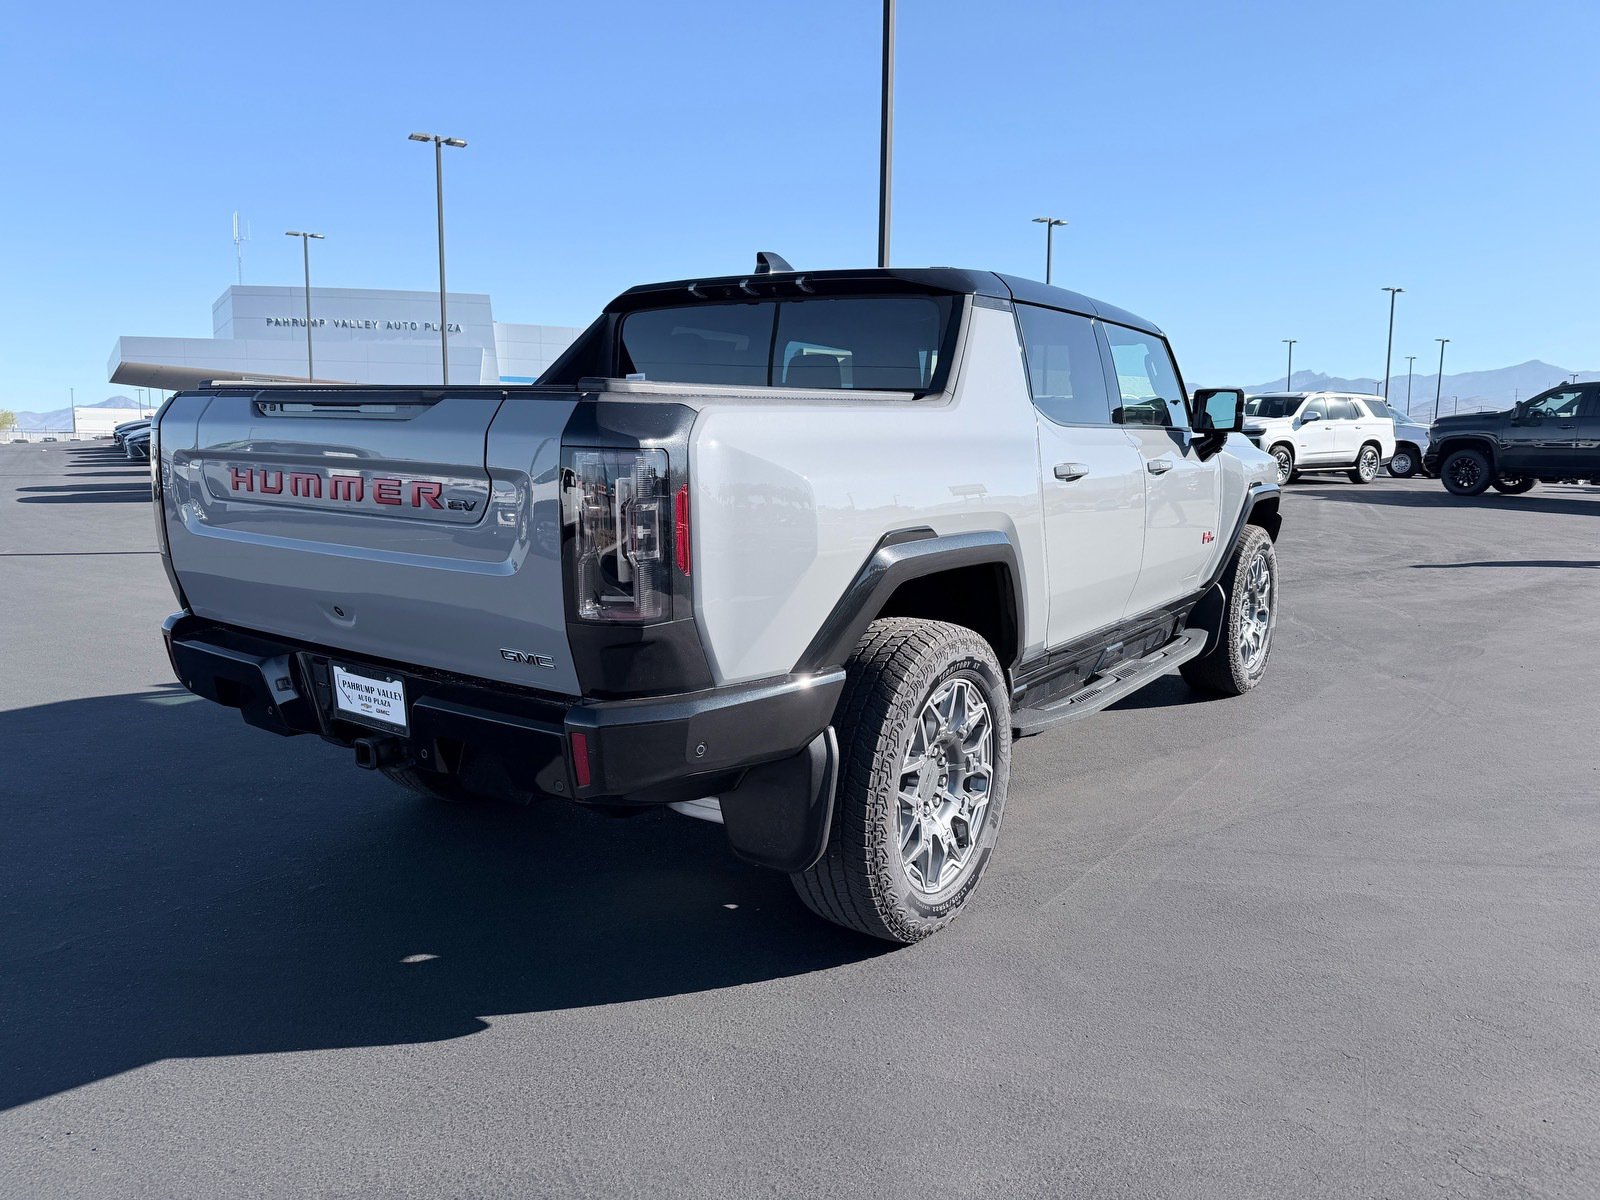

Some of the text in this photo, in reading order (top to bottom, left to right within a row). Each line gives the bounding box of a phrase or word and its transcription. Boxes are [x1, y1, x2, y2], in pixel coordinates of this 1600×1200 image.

[266, 317, 325, 328] PAHRUMP
[334, 319, 378, 329] VALLEY
[386, 321, 417, 331] AUTO
[231, 467, 478, 512] HUMMER EV
[499, 647, 557, 670] GMC
[939, 660, 972, 684] TERRITORY
[342, 680, 402, 701] PAHRUMP VALLEY
[357, 694, 391, 707] AUTO PLAZA
[376, 708, 390, 716] GMC
